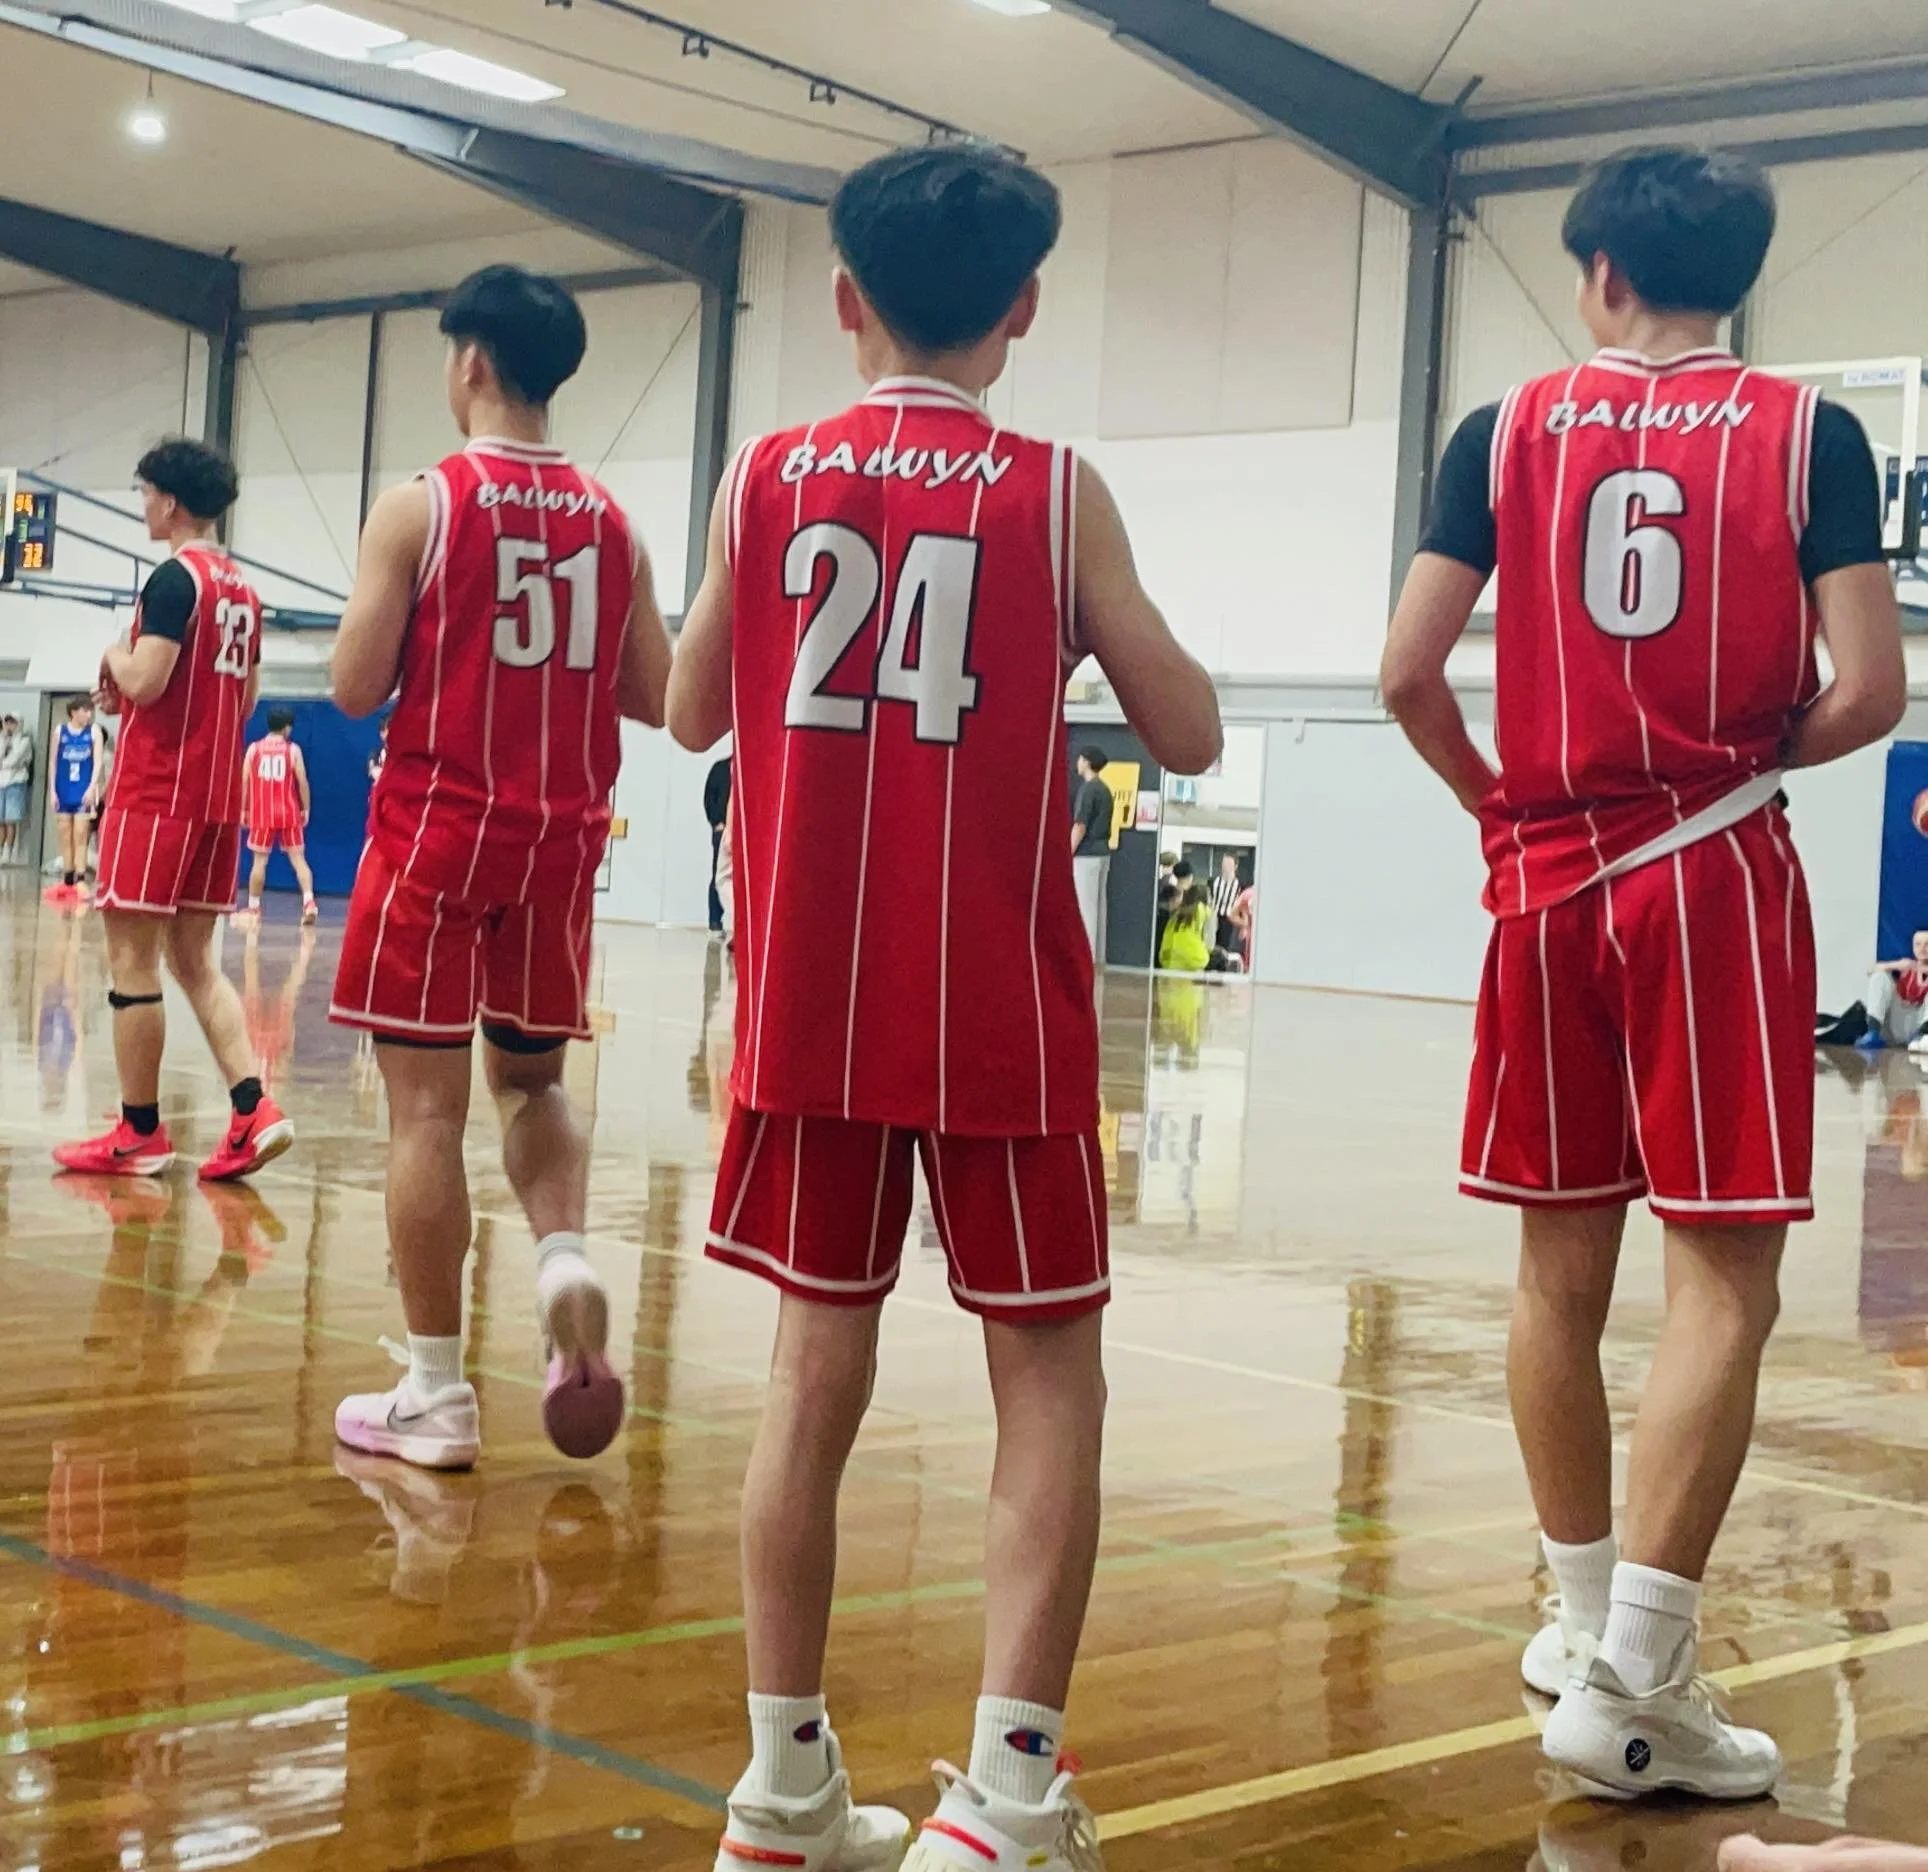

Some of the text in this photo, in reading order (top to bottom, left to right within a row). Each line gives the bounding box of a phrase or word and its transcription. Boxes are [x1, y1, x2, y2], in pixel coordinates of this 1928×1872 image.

[1545, 399, 1755, 436] BALWYN
[780, 441, 1014, 489] BALWYN
[477, 481, 608, 518] BALWYN
[1582, 467, 1686, 638] 6
[493, 536, 600, 672] 51
[782, 520, 981, 744] 24
[213, 596, 255, 679] 23
[257, 753, 286, 782] 40
